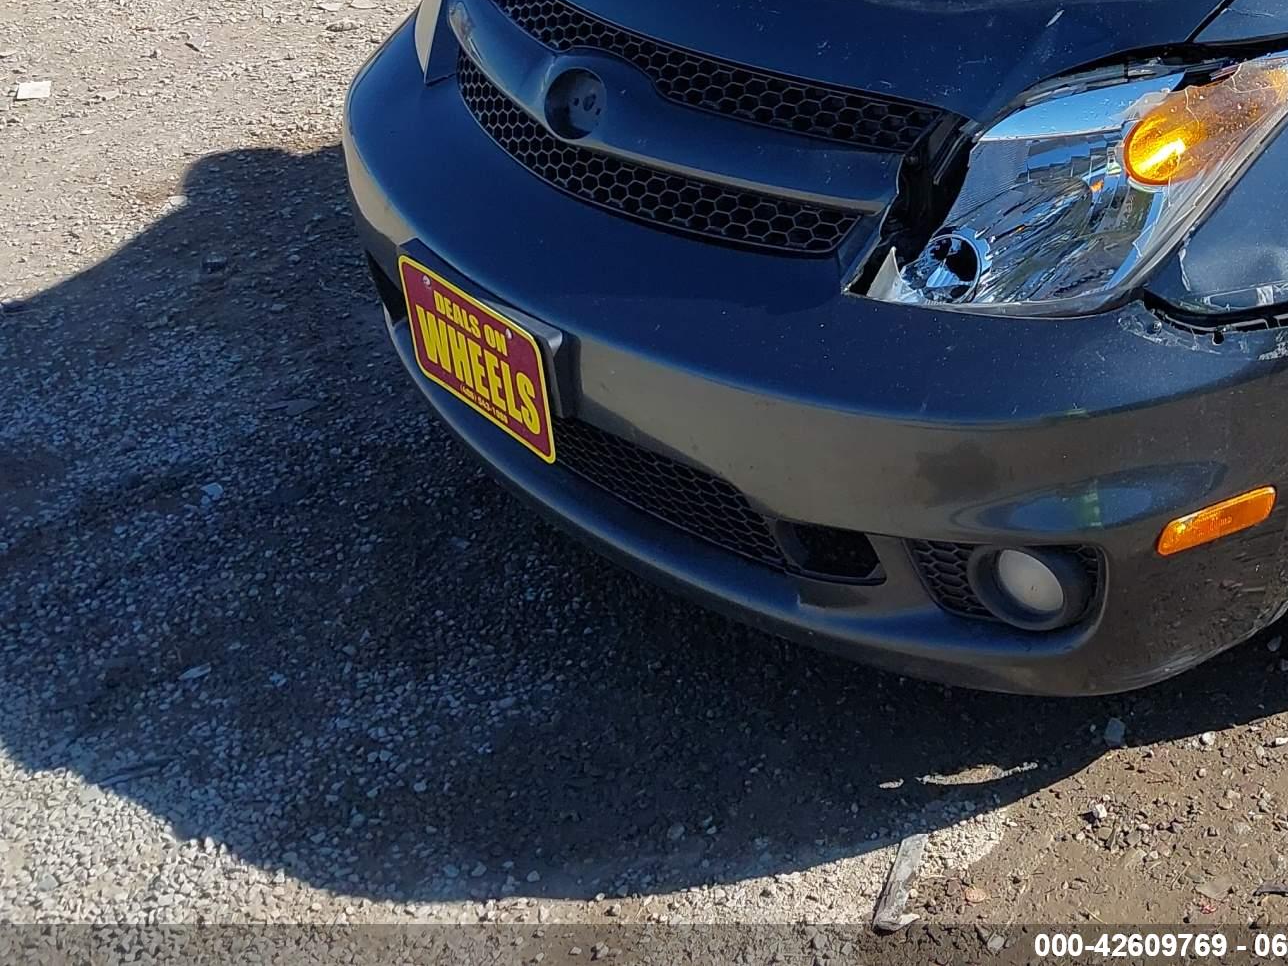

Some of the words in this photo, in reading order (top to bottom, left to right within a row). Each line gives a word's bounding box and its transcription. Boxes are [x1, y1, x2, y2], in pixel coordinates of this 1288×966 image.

[415, 304, 541, 435] WHEELS
[433, 289, 482, 339] DEALS
[483, 323, 508, 357] ON
